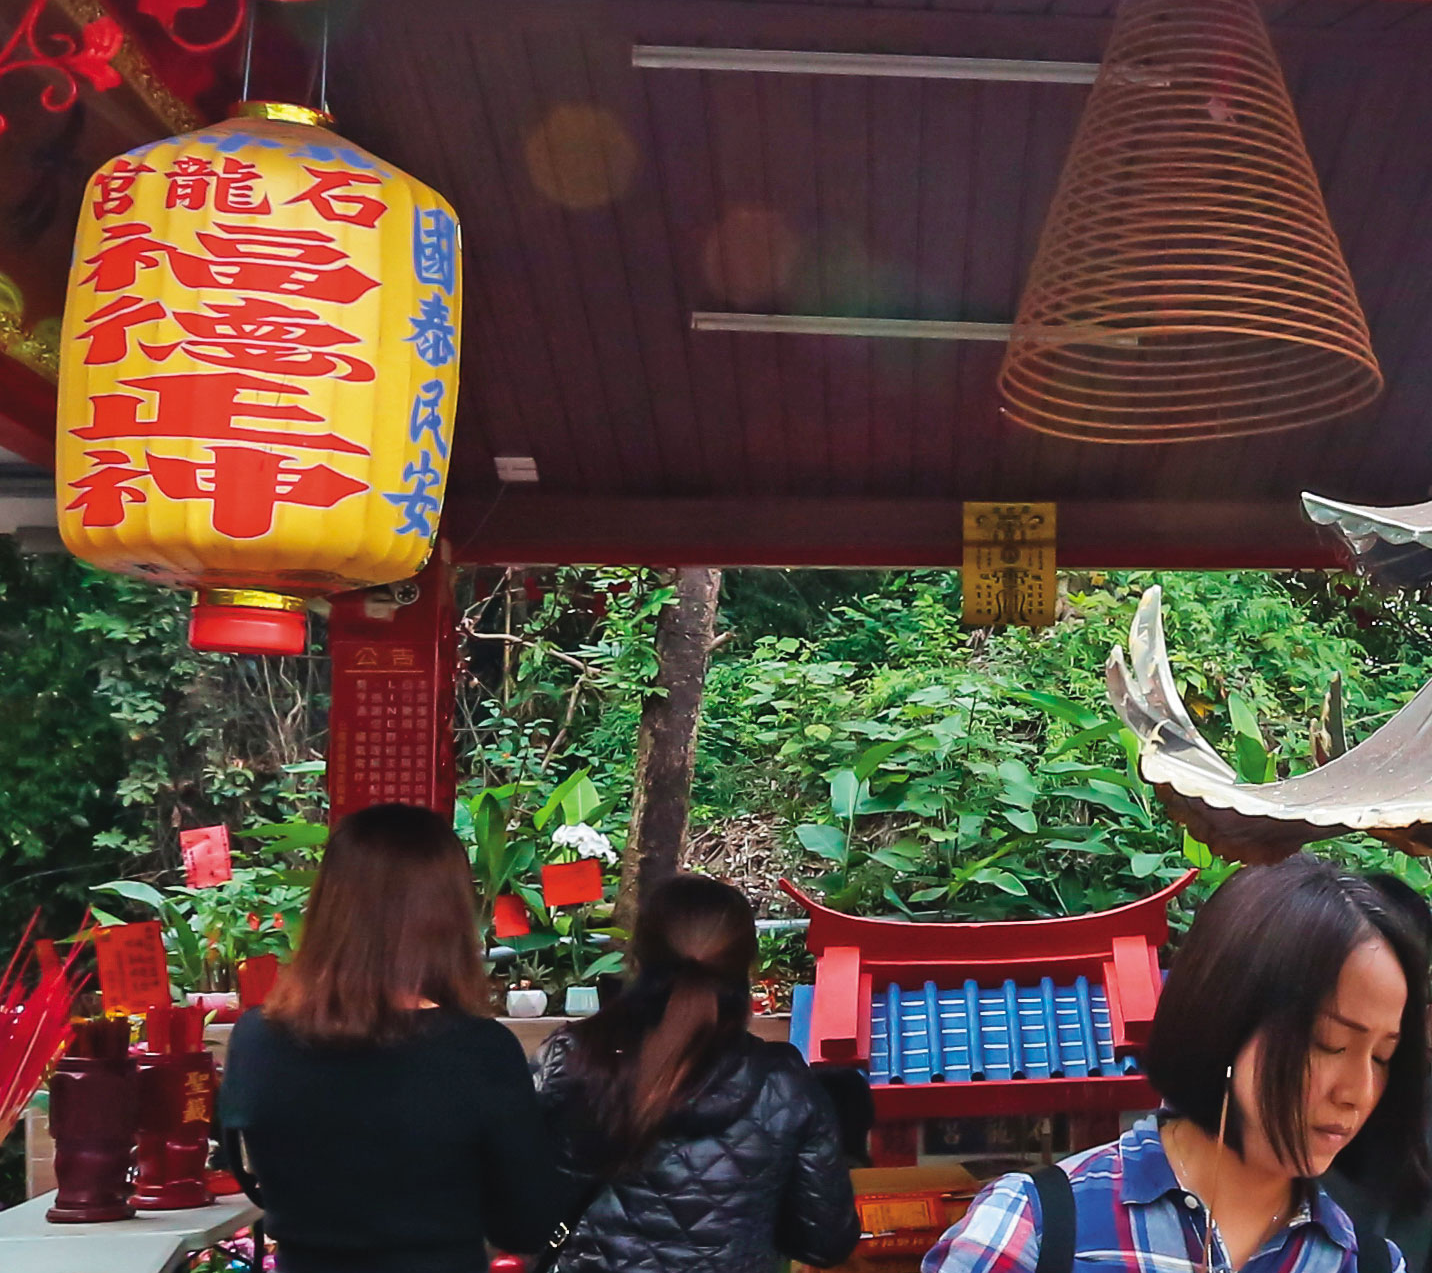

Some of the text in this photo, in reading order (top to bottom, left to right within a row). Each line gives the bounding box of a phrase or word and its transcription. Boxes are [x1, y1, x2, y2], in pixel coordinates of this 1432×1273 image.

[91, 155, 389, 229] 石龍宮
[65, 221, 383, 539] 福德正神
[382, 204, 459, 538] 國泰民安
[355, 647, 414, 666] 公告
